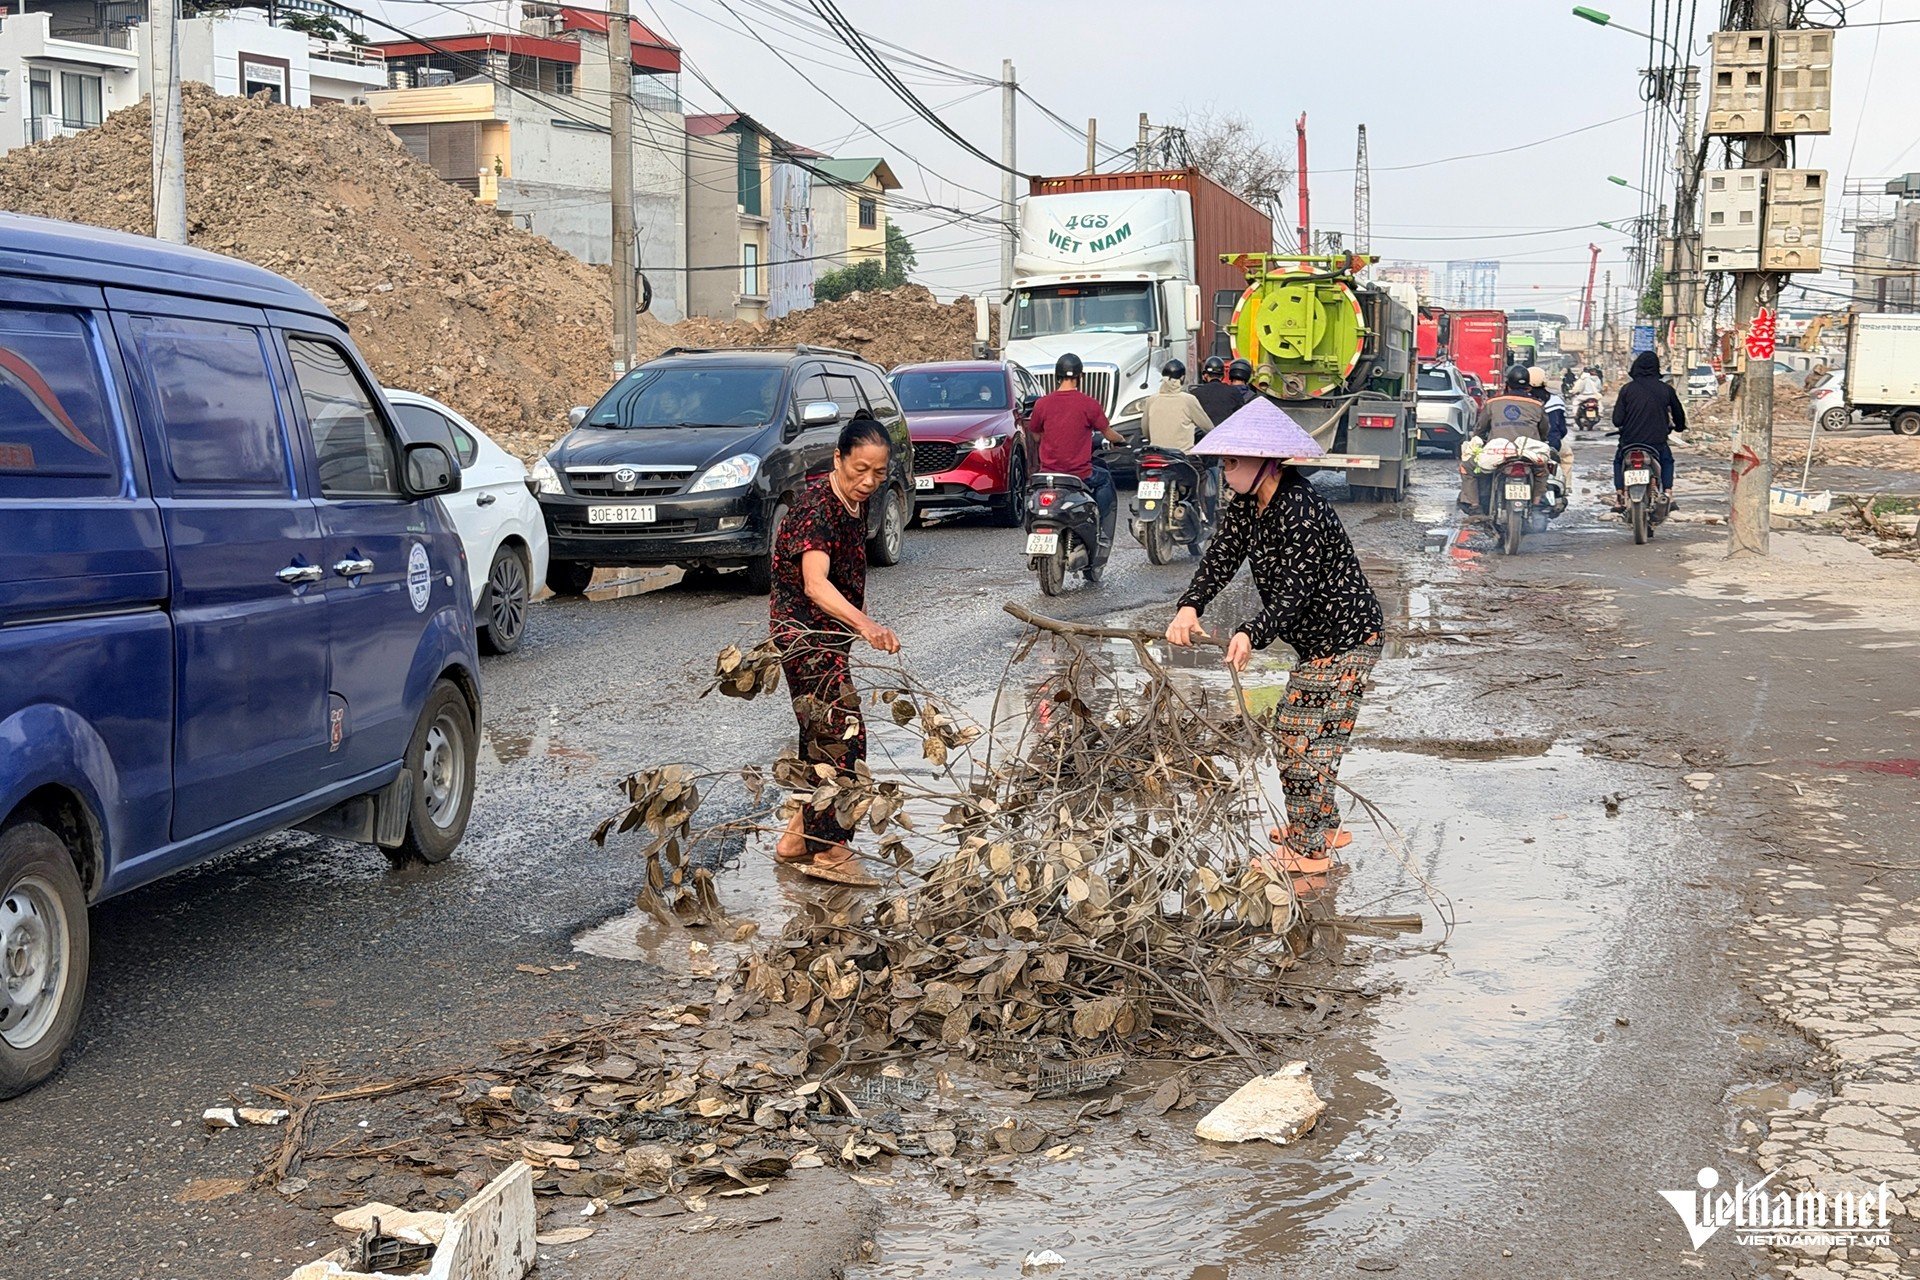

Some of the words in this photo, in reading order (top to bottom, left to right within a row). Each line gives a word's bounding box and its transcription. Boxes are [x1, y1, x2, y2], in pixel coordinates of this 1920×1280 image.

[1065, 214, 1109, 231] 4GS
[1048, 228, 1083, 255] VIỆT
[1089, 222, 1132, 253] NAM
[590, 507, 653, 522] 30E-812.11
